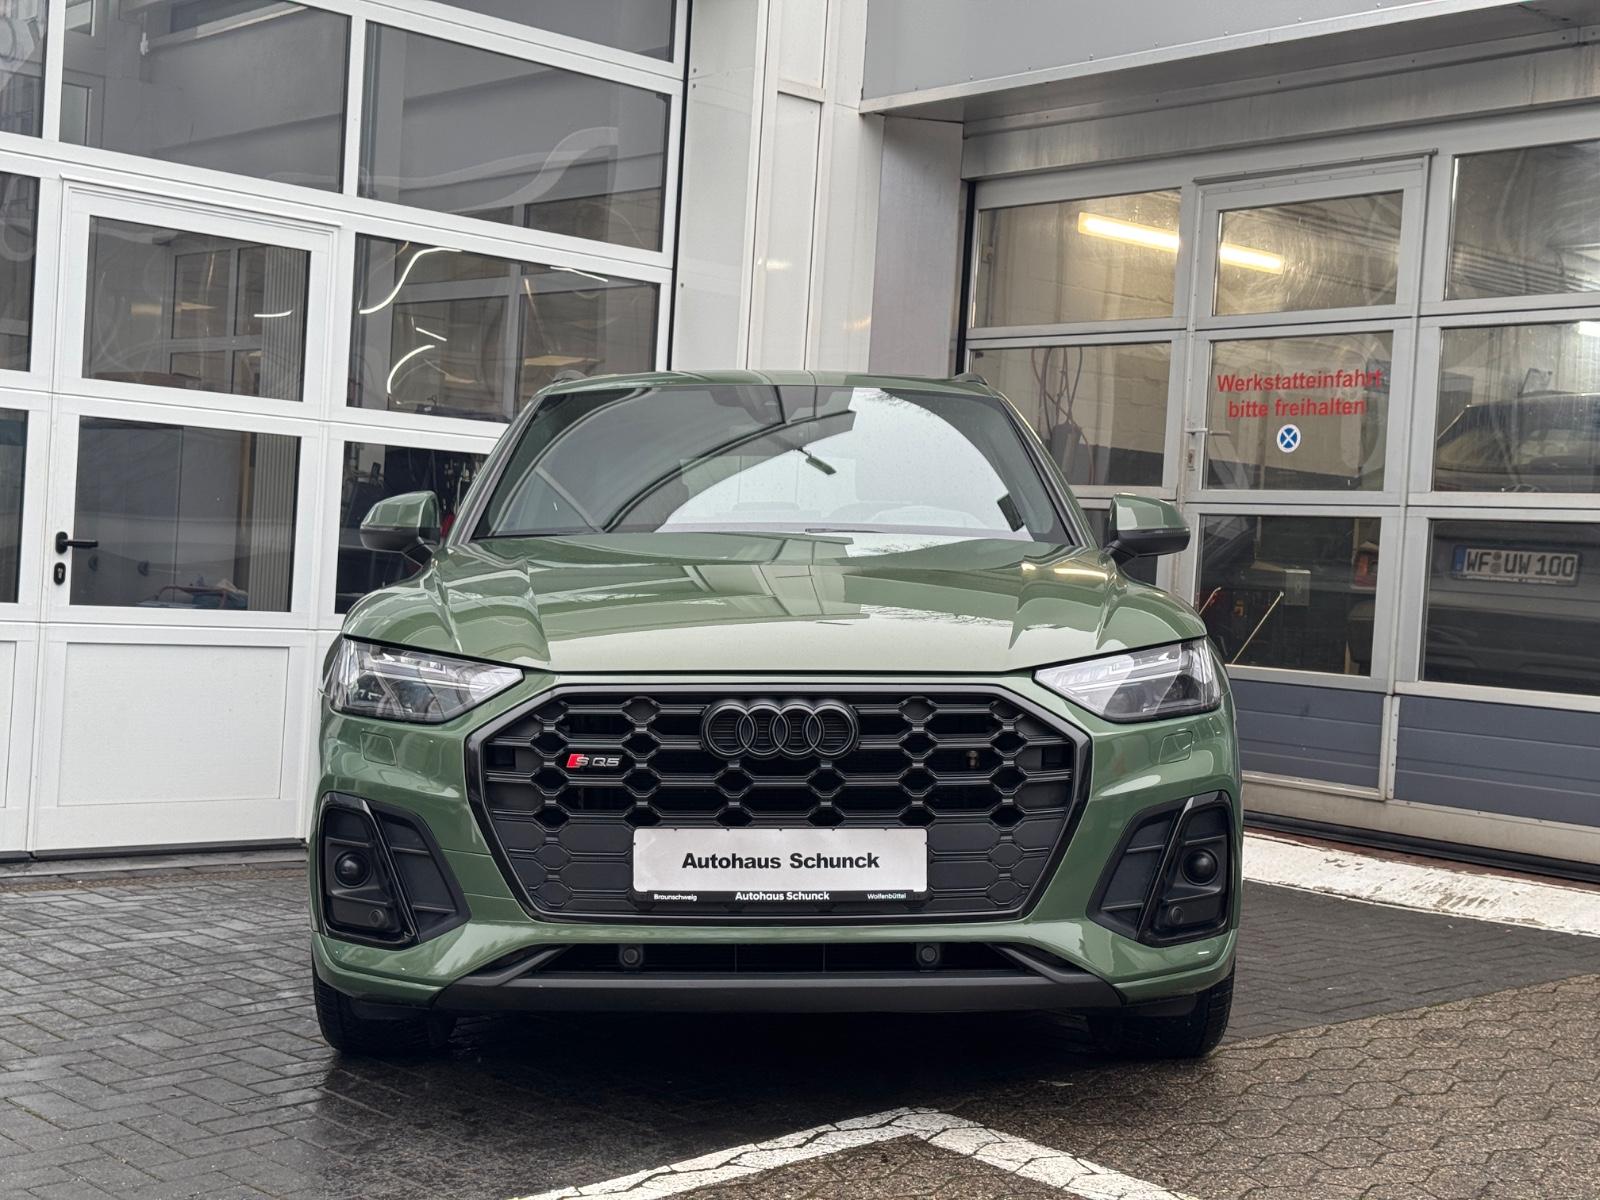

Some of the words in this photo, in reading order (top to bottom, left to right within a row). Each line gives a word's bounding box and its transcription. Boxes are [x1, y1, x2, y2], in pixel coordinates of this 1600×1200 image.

[1216, 368, 1383, 393] Werkstatteinfahrt
[1228, 400, 1269, 418] bitte
[1275, 397, 1367, 417] freihalten
[1466, 551, 1492, 572] WF
[1503, 553, 1531, 575] UW
[1535, 555, 1576, 577] 100
[681, 852, 781, 869] Autohaus
[789, 852, 880, 869] Schunck
[653, 893, 698, 902] Braunschweig
[734, 891, 785, 901] Autohaus
[786, 891, 830, 901] Schunck
[867, 892, 907, 900] Wolfenbüttel
